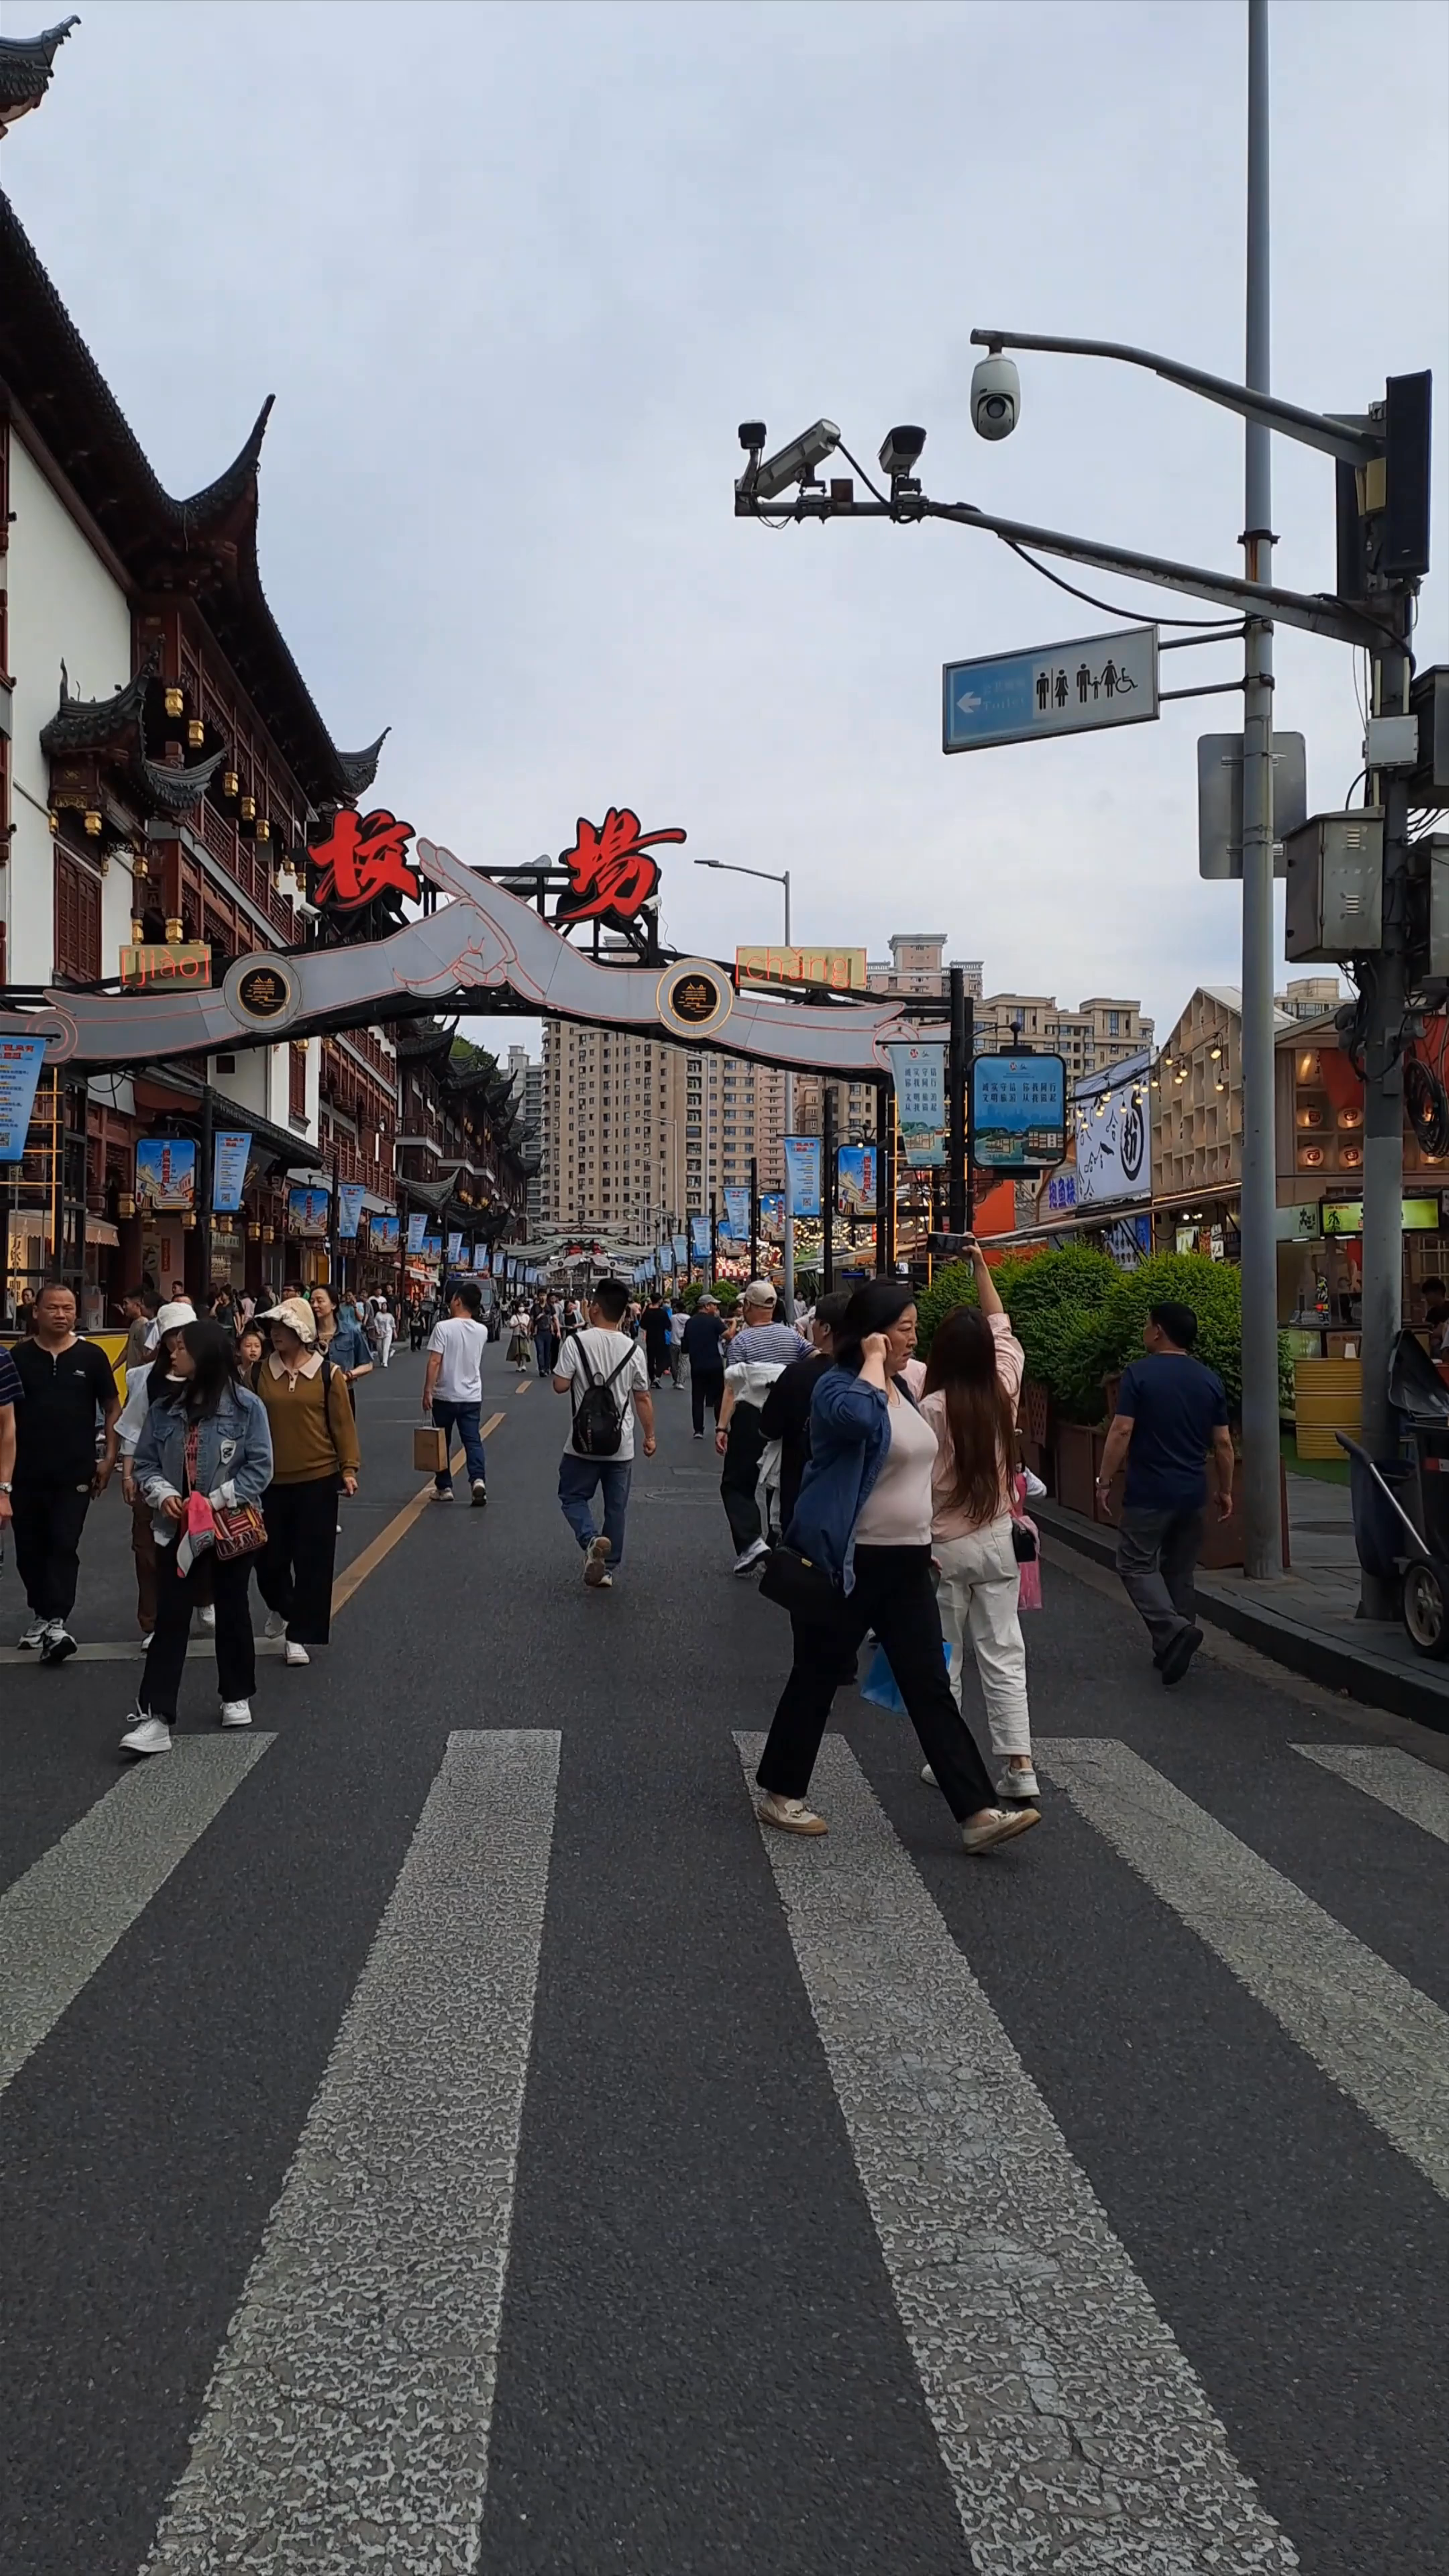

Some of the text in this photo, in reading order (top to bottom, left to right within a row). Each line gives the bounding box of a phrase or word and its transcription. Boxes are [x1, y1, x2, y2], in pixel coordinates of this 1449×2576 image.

[905, 1093, 937, 1102] 文明旅游
[982, 1093, 1057, 1103] 文明旅游 从我做起
[905, 1103, 937, 1112] 从我做起
